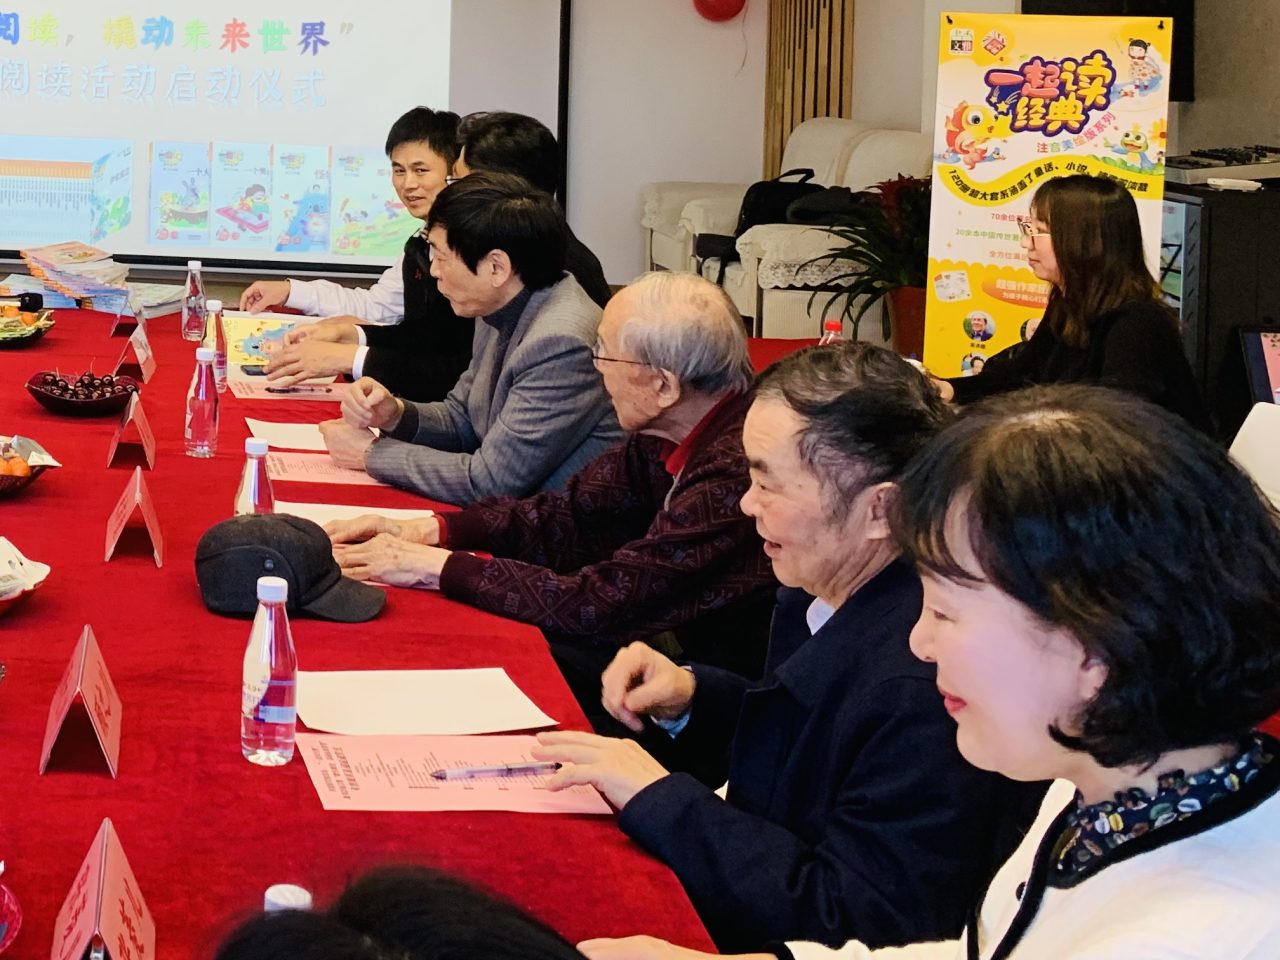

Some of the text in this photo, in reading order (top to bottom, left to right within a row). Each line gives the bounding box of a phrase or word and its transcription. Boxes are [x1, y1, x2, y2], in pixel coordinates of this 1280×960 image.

[988, 54, 1112, 106] 一起读
[1016, 94, 1085, 132] 经典
